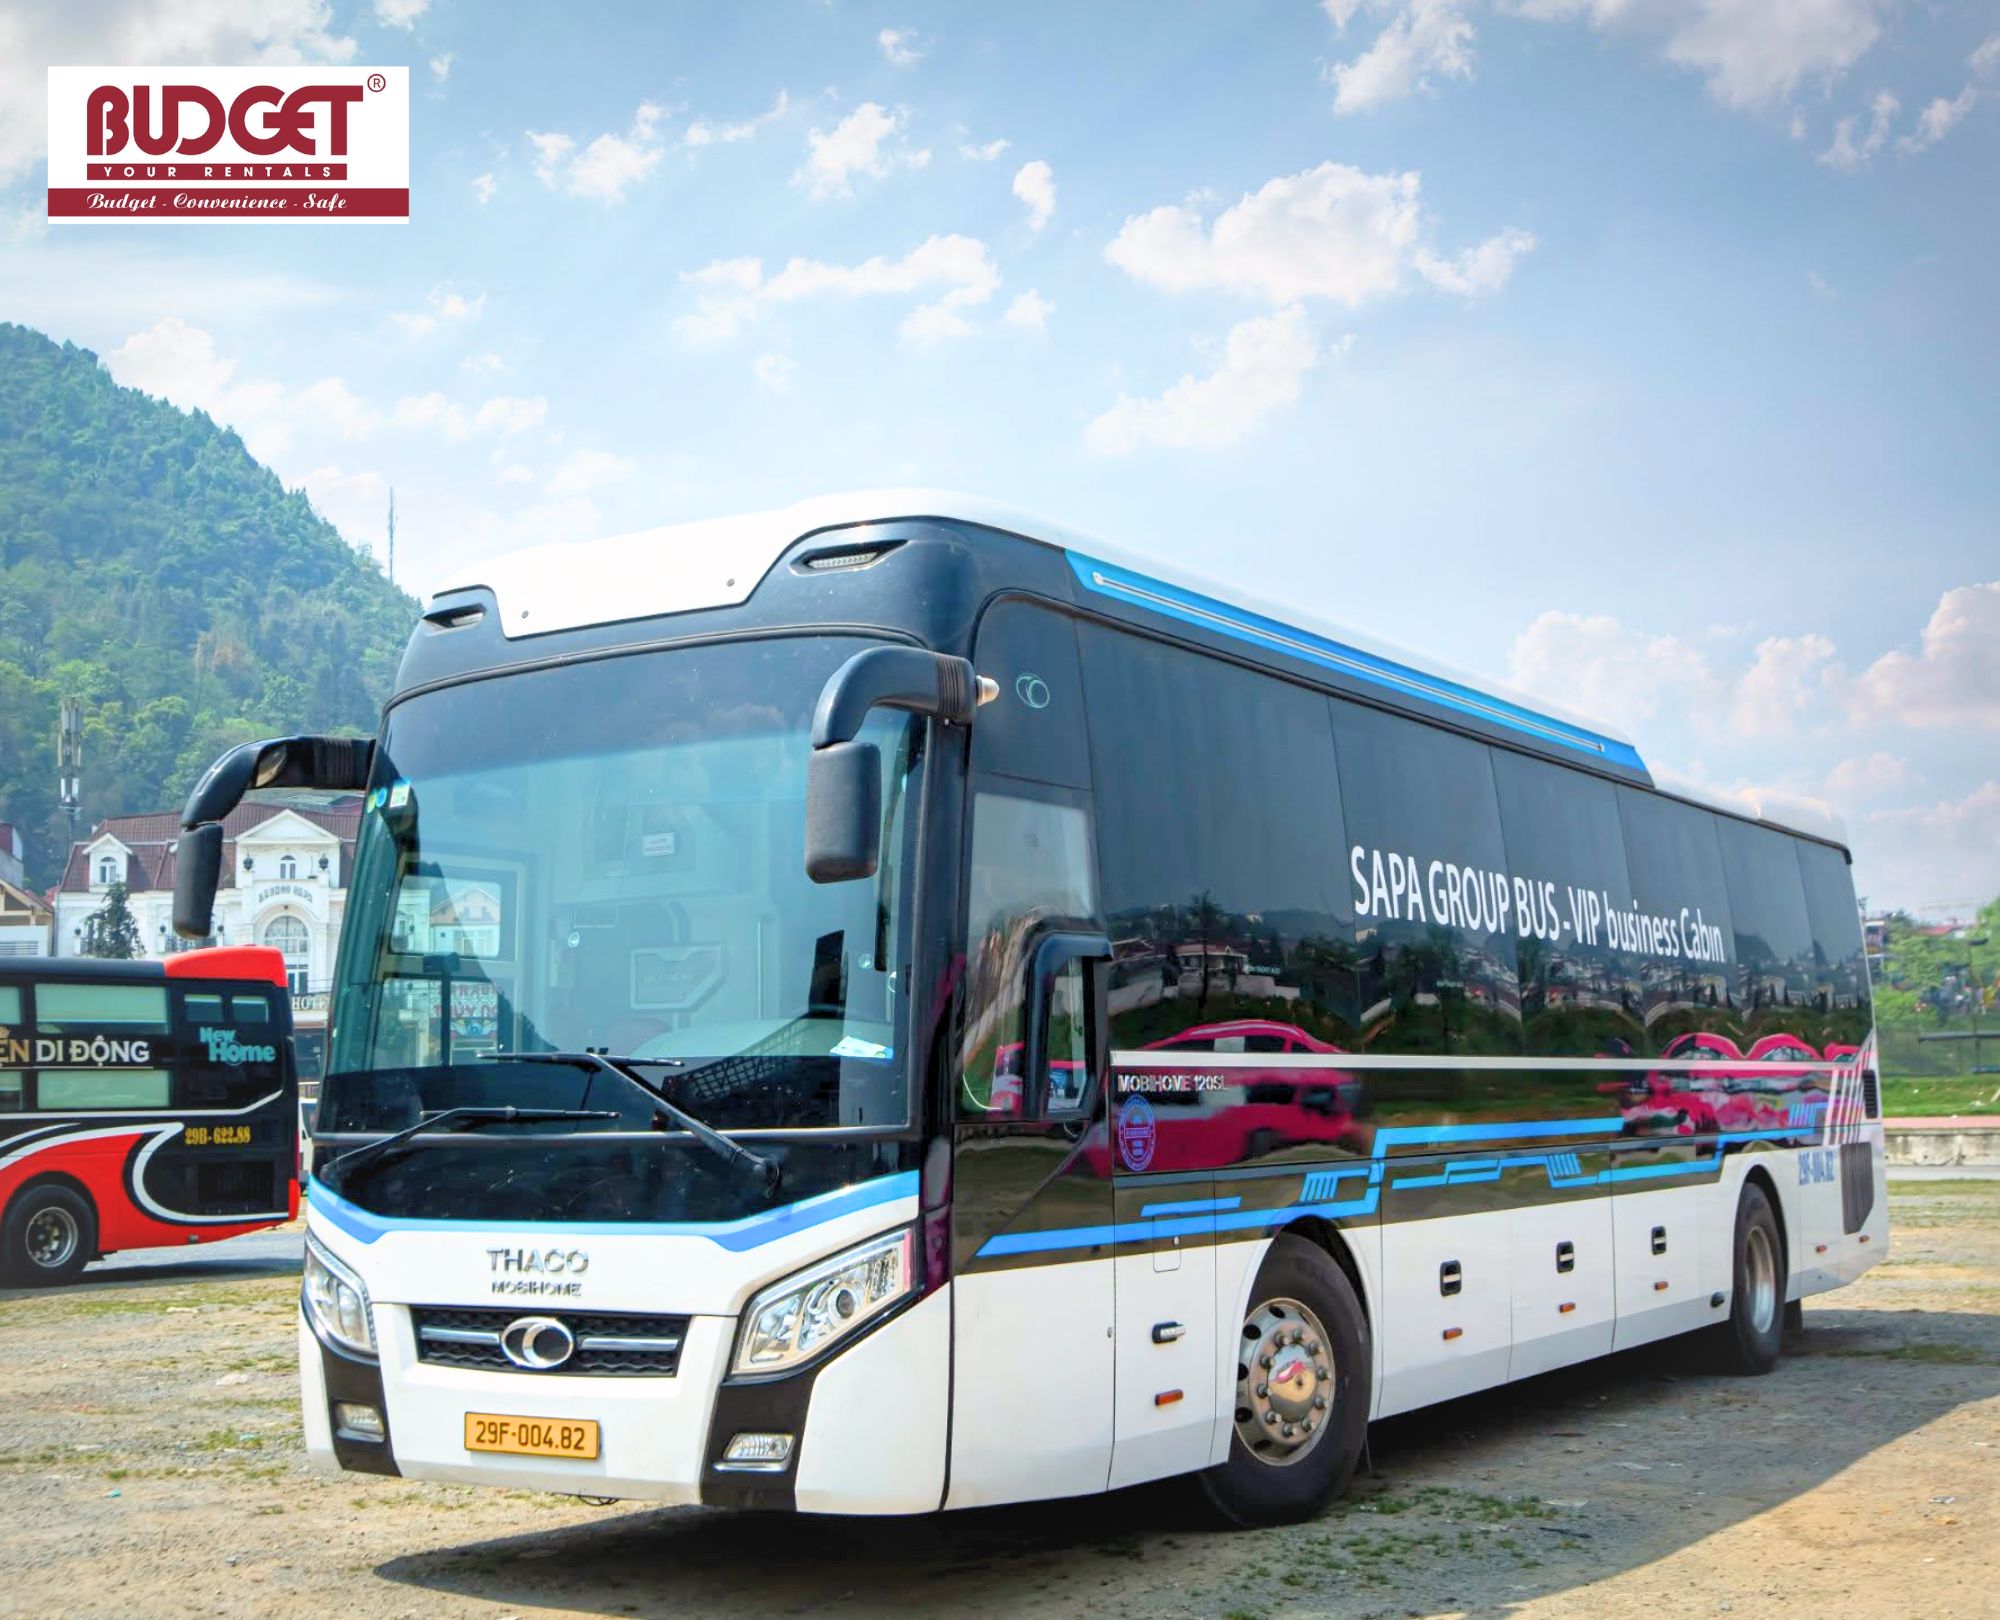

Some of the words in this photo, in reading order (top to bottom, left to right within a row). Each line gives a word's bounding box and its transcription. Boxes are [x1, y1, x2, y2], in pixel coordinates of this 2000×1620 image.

[1351, 845, 1426, 922] SAPA
[1428, 860, 1510, 933] GROUP
[1513, 876, 1560, 941] BUS
[1567, 886, 1599, 946] VIP
[1604, 891, 1679, 957] business
[291, 995, 330, 1010] HOTE
[200, 1027, 235, 1042] New
[36, 1040, 64, 1062] DI
[69, 1035, 150, 1067] ĐỘNG
[209, 1041, 276, 1065] Home
[486, 1248, 589, 1273] THACO
[476, 1420, 585, 1450] 29F-004.82
